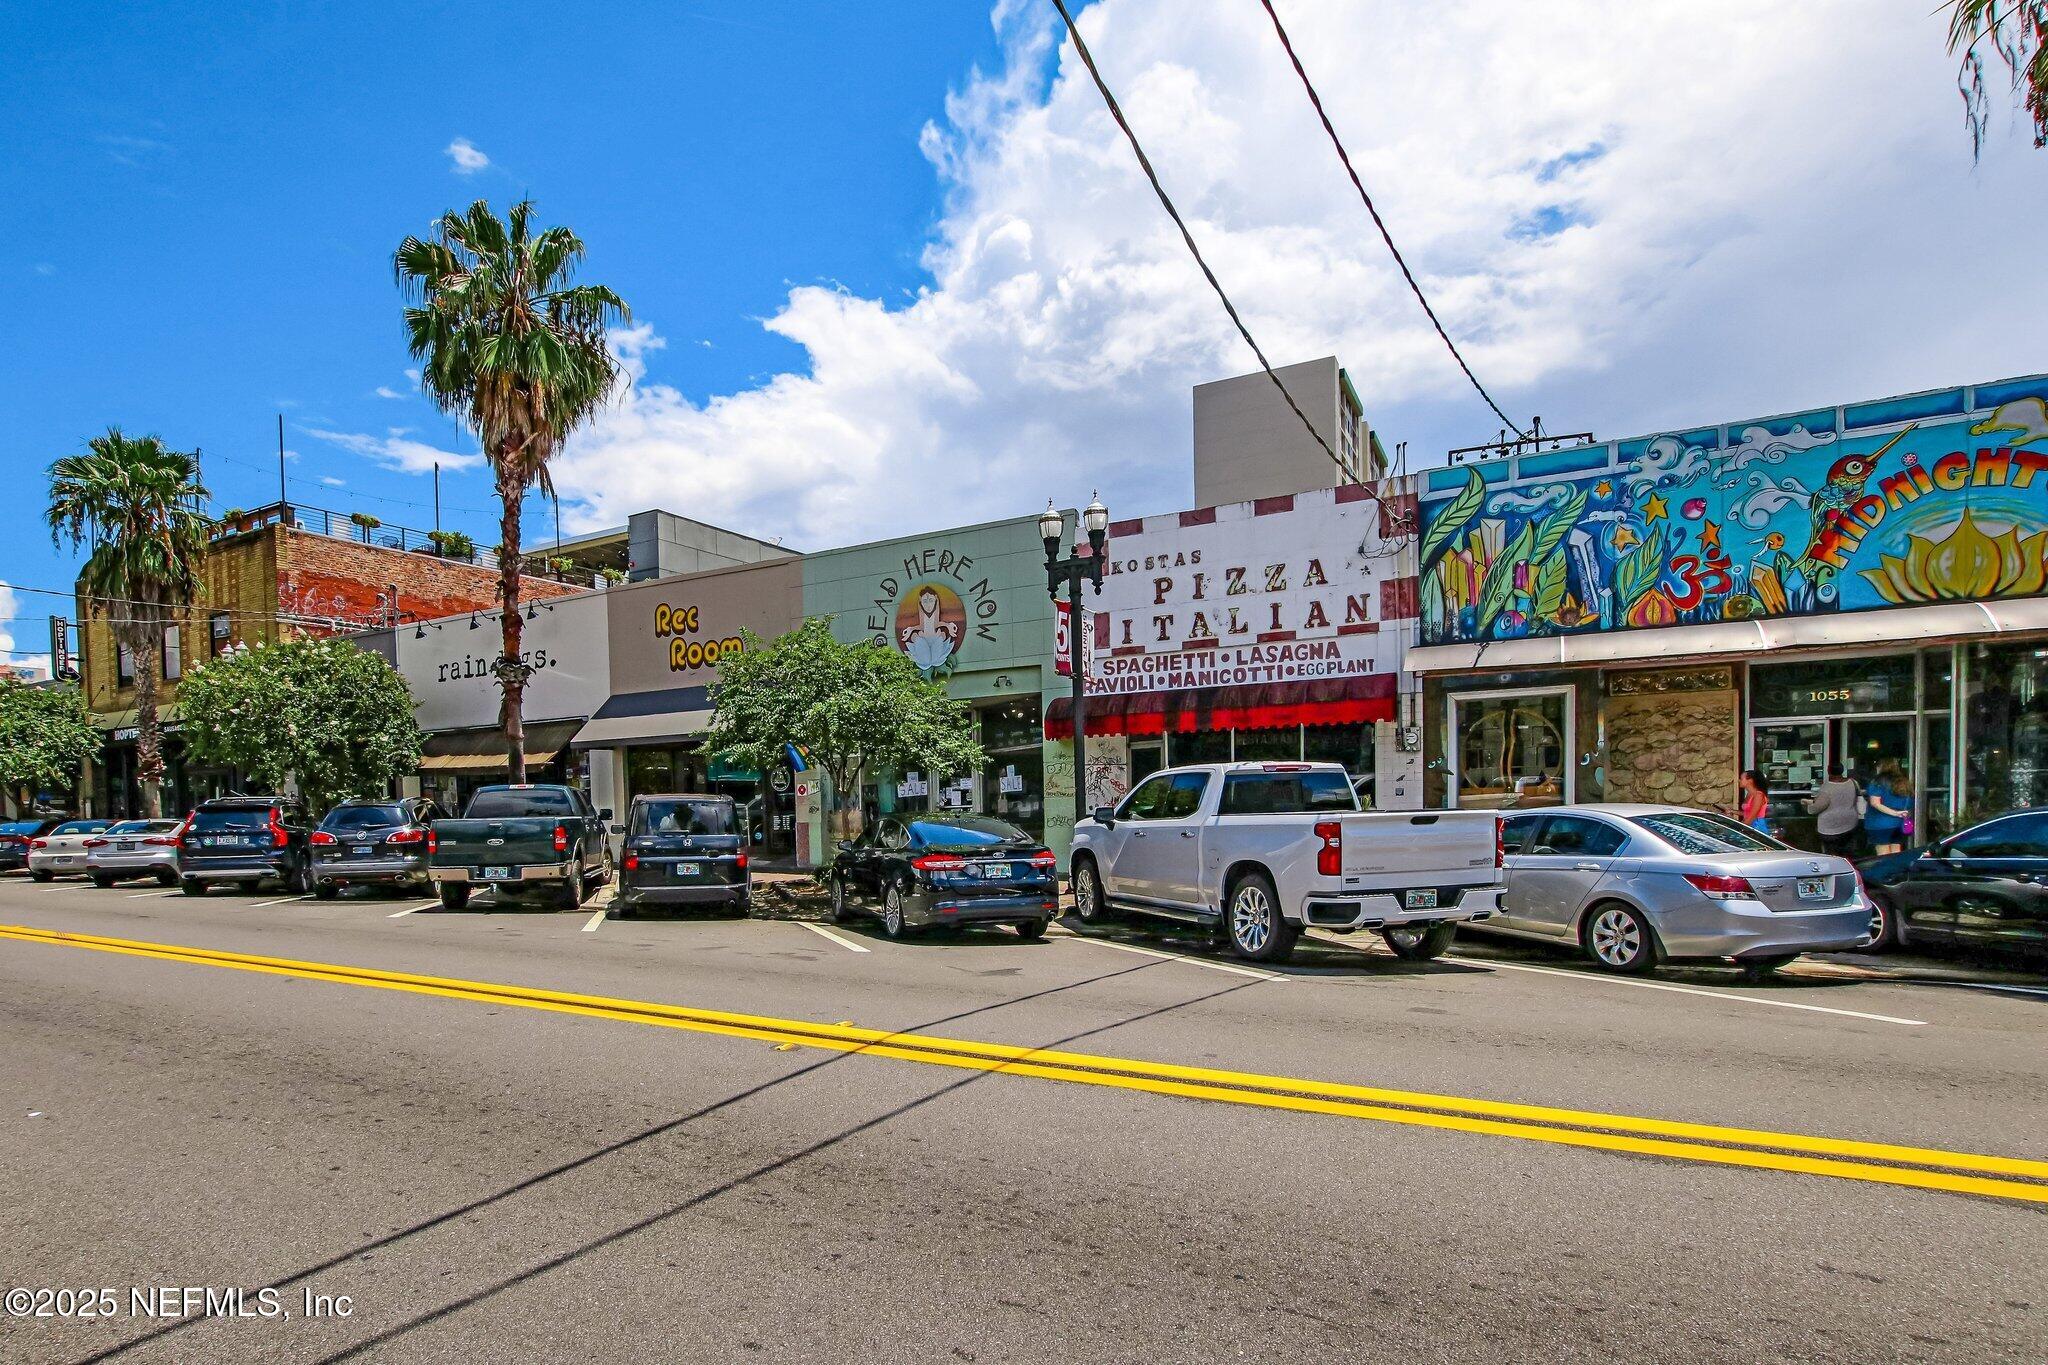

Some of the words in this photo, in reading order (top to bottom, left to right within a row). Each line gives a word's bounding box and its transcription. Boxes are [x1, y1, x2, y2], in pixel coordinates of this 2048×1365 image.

[1808, 447, 2048, 571] MIDNIGHT
[1111, 550, 1201, 575] KOSTAS
[1153, 558, 1329, 605] PIZZA
[903, 549, 974, 582] HERE
[968, 577, 998, 643] NOW
[655, 602, 699, 638] Rec
[1056, 611, 1069, 652] 5
[1121, 593, 1372, 645] ITALIAN
[56, 620, 66, 672] HOPTINGER
[1103, 651, 1216, 676] SPAGHETTI
[1236, 641, 1342, 666] LASAGNA
[1083, 674, 1155, 695] RAVIOLI
[1168, 664, 1284, 689] MANICOTTI
[1297, 658, 1375, 676] EGGPLANT
[1809, 689, 1850, 702] 1055
[899, 782, 927, 796] SALE
